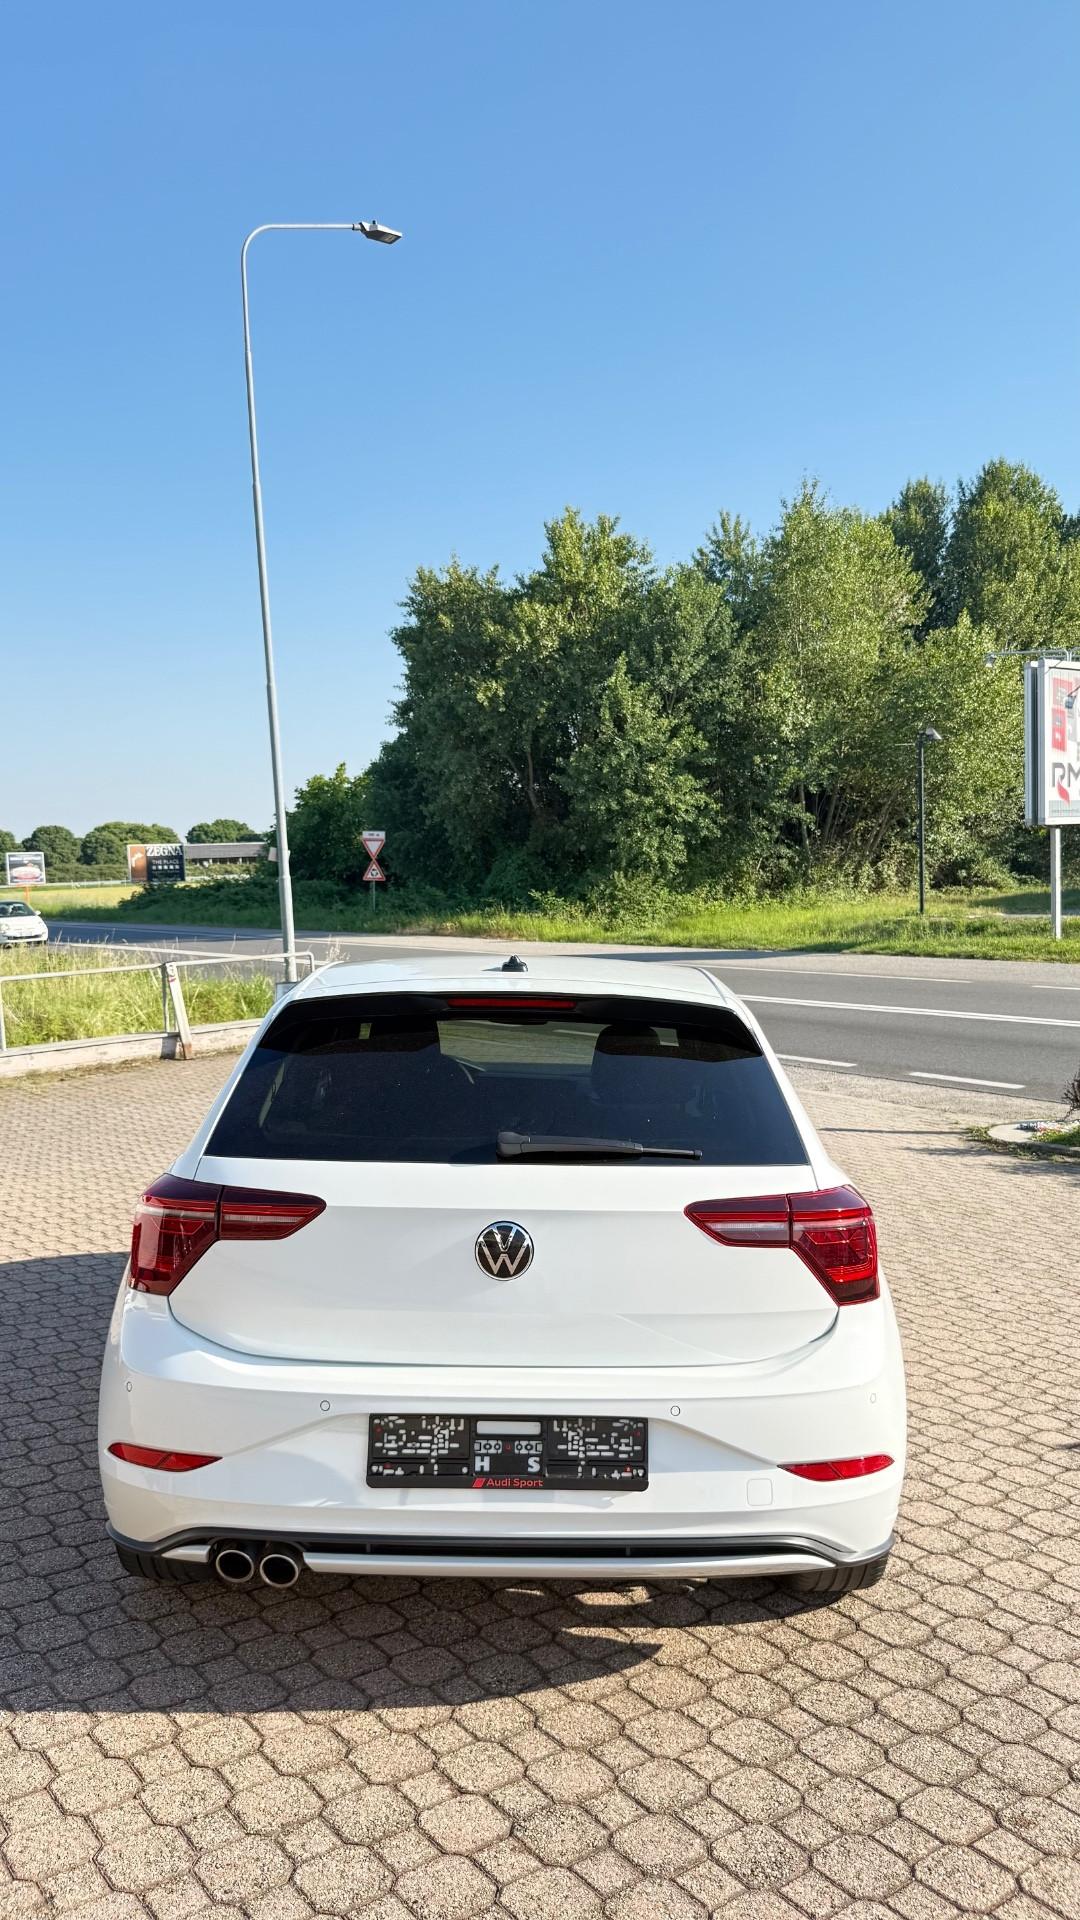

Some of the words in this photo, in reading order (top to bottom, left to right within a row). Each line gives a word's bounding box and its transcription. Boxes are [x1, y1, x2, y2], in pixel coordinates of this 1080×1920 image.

[146, 846, 183, 856] ZEGNA
[476, 1222, 533, 1279] VW
[474, 1456, 490, 1472] H
[527, 1456, 541, 1473] S
[486, 1478, 511, 1487] Audi
[513, 1478, 543, 1488] Sport
